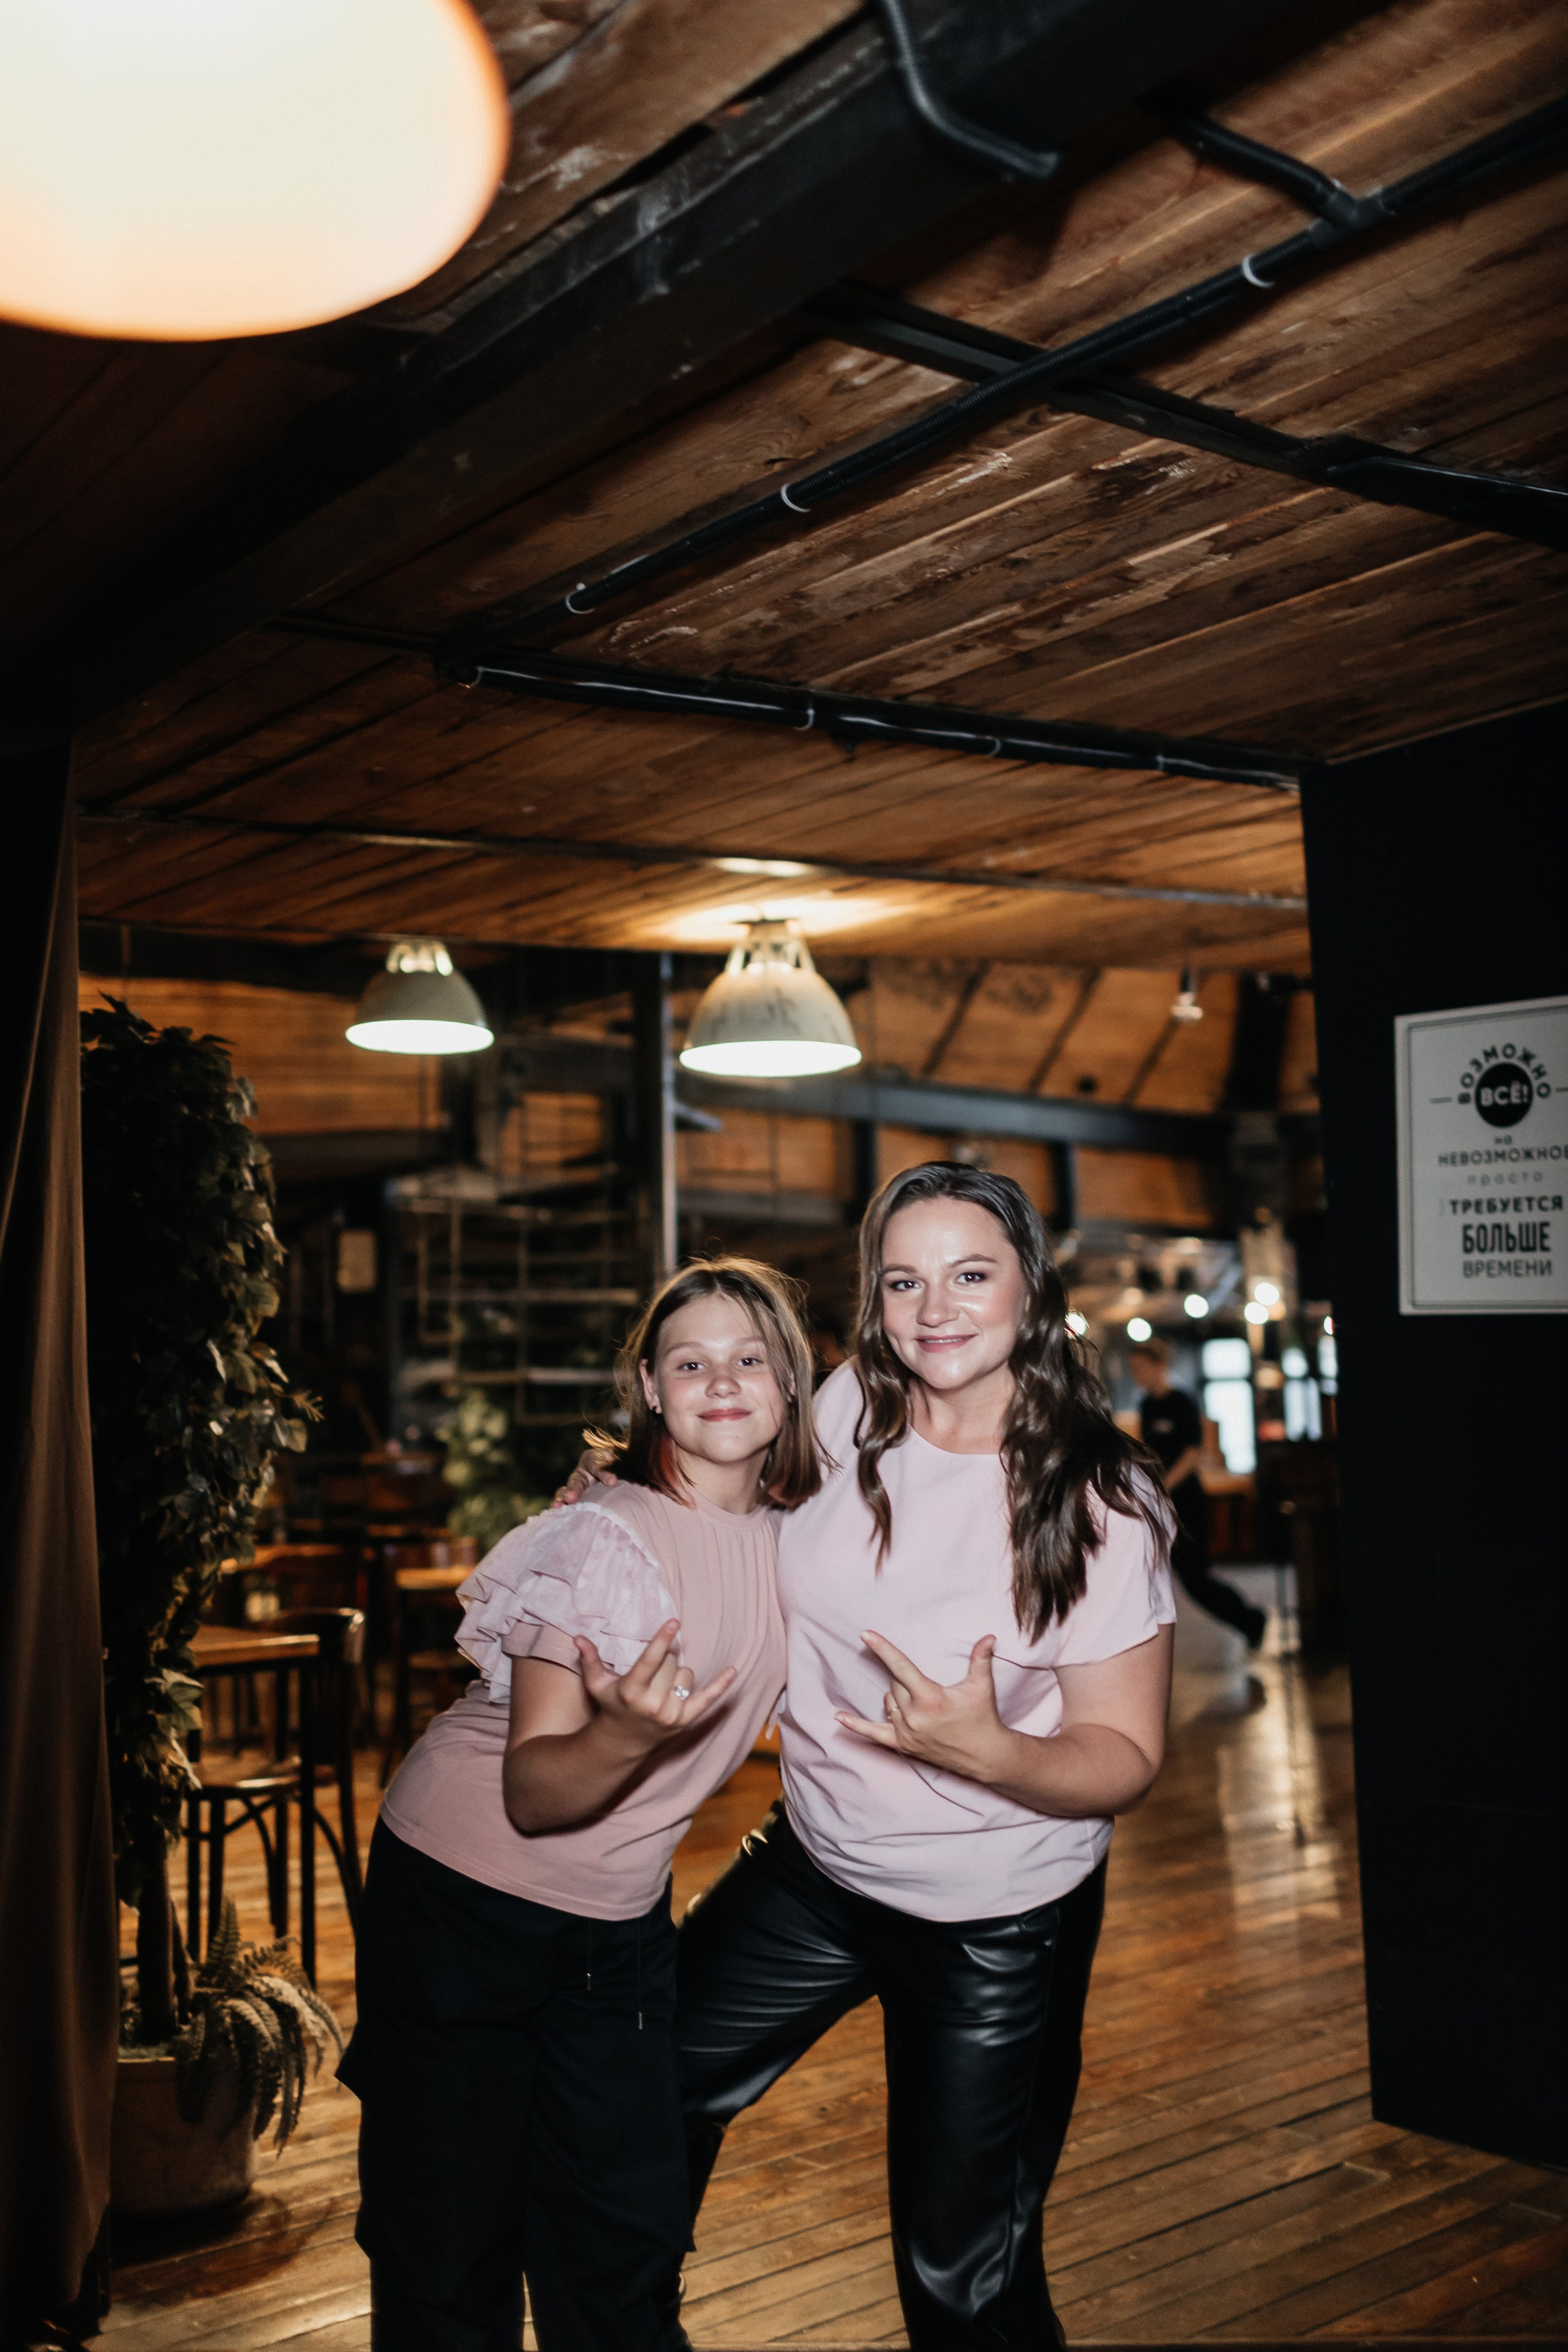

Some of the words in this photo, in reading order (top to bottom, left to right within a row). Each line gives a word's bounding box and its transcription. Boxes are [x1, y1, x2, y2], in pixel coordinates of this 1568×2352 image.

[1450, 1195, 1563, 1215] ТРЕБУЕТСЯ
[1462, 1219, 1551, 1254] БОЛЬШЕ
[1463, 1259, 1552, 1278] ВРЕМЕНИ
